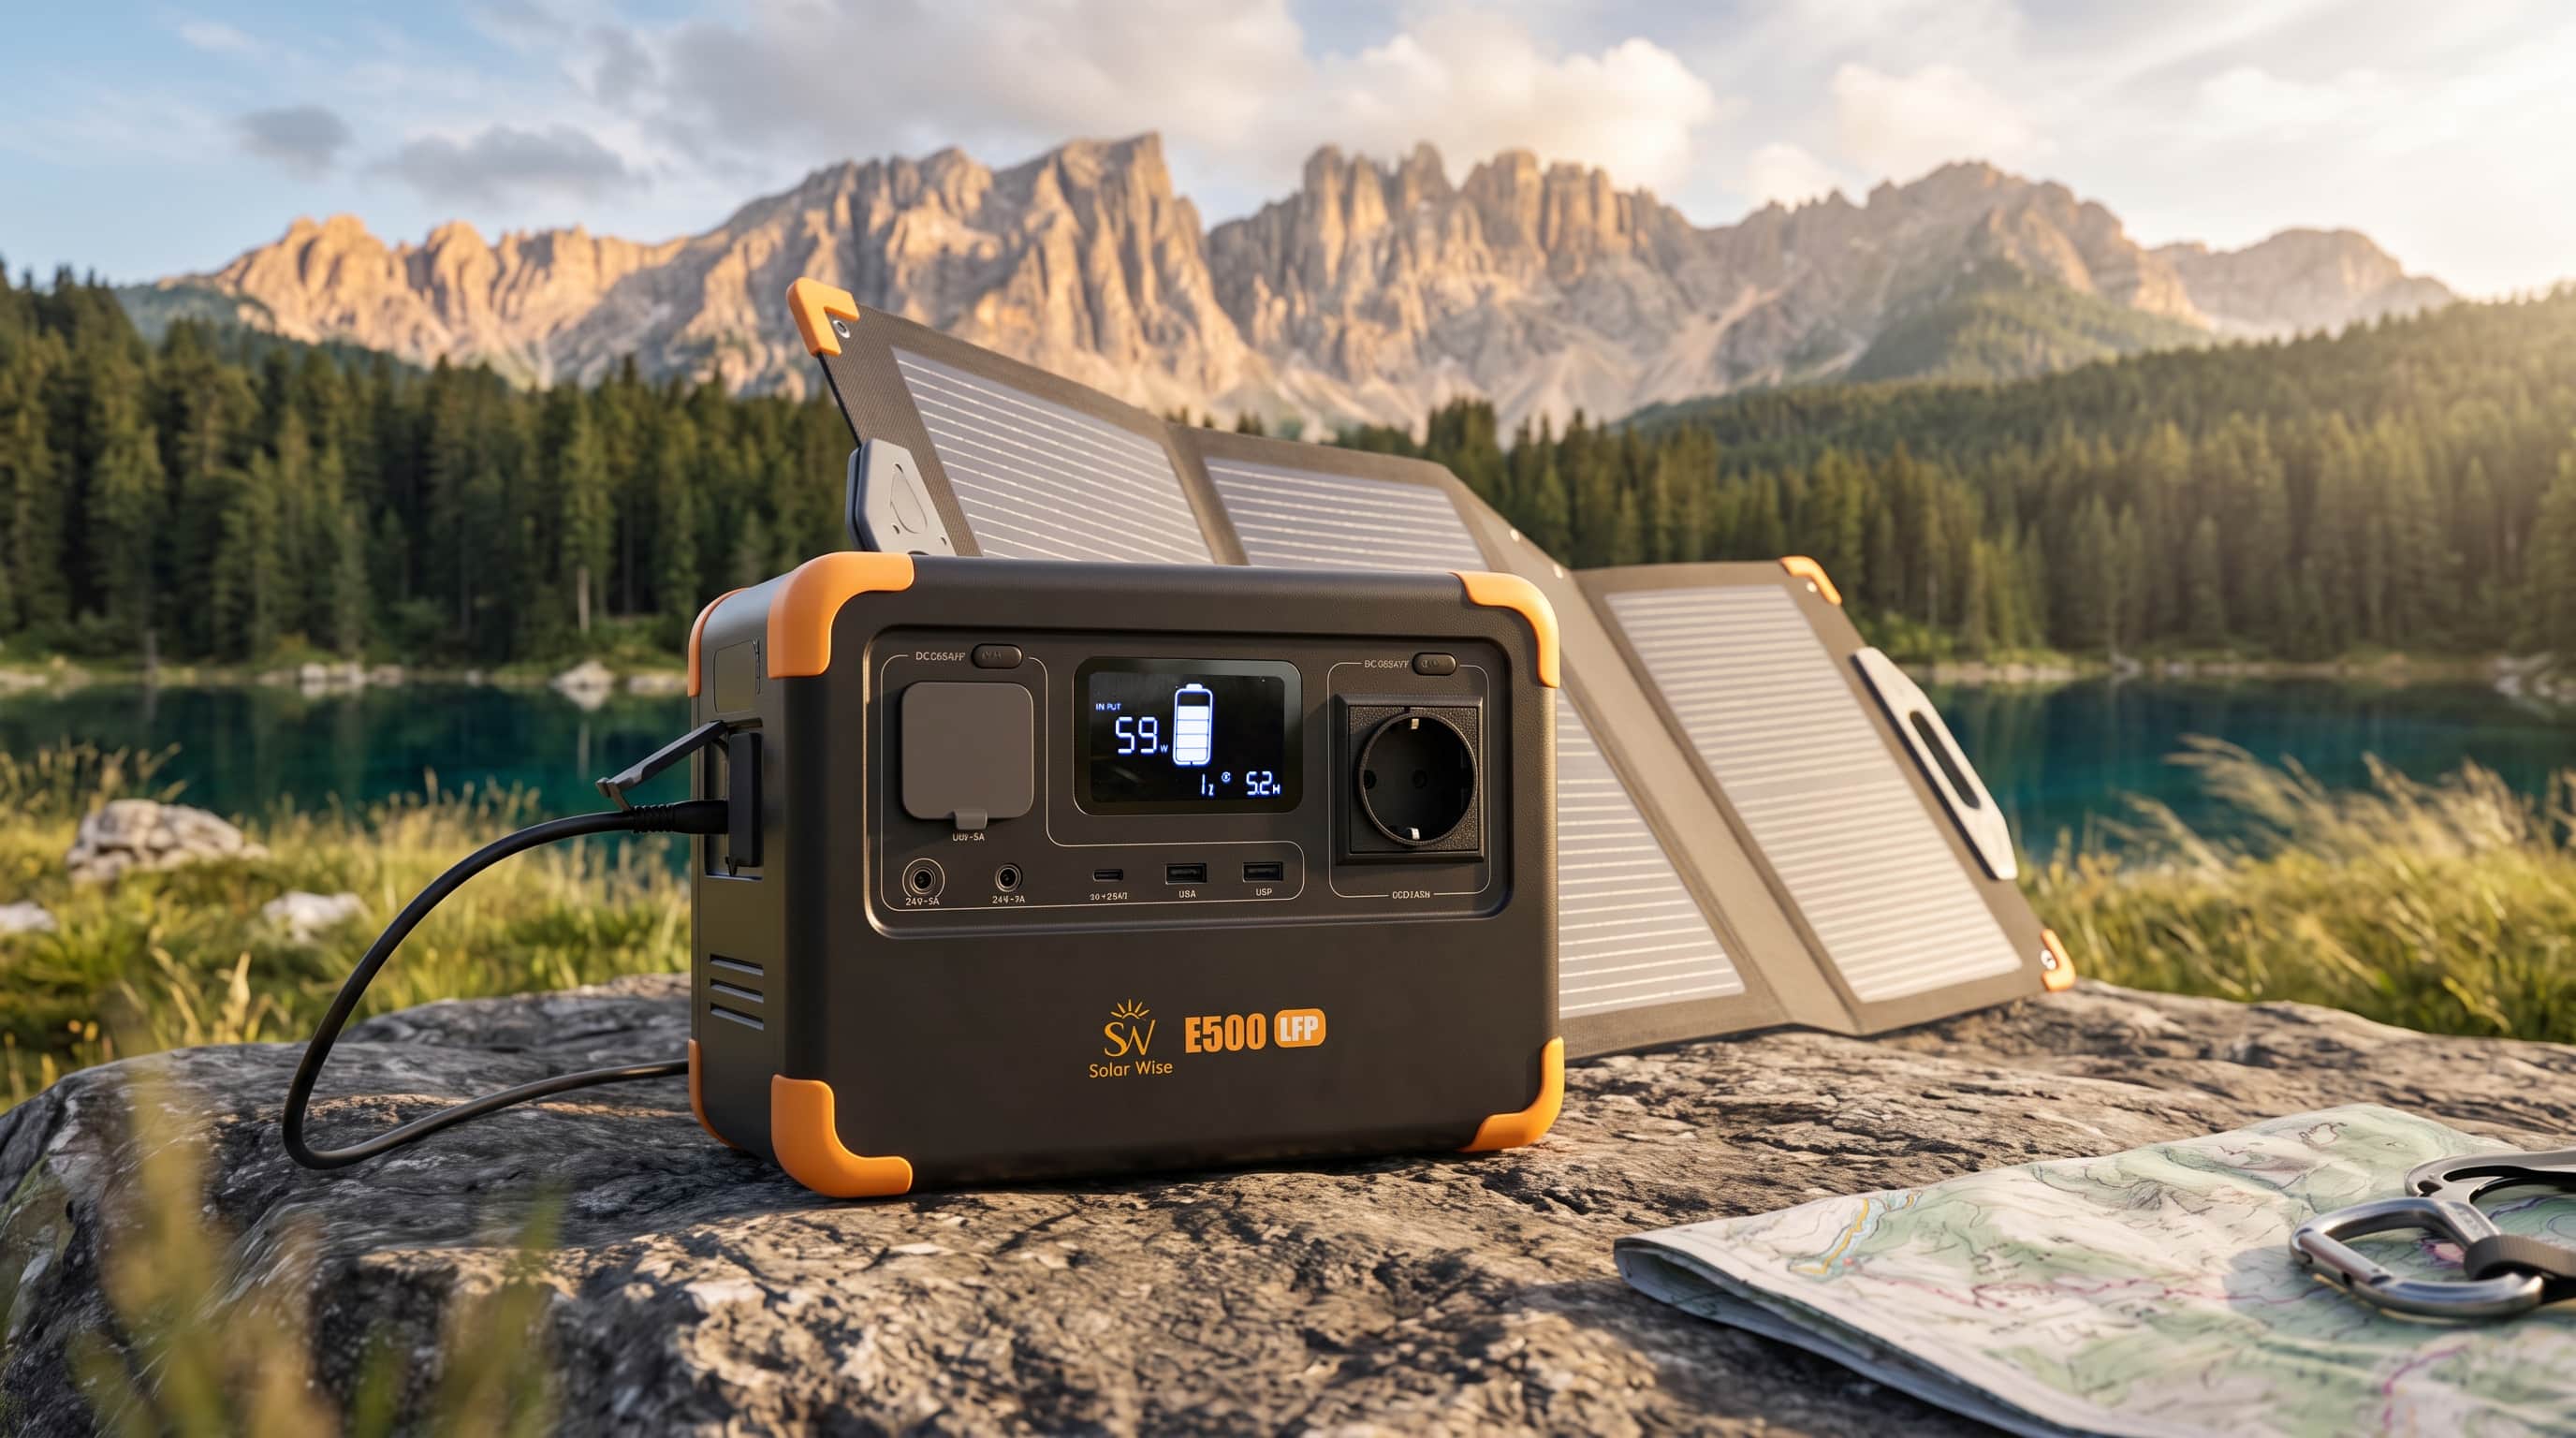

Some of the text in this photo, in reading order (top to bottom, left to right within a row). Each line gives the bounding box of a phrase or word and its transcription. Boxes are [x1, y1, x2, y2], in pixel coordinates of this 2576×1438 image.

[1178, 889, 1197, 899] USA
[1255, 888, 1273, 897] USP
[1184, 1012, 1319, 1054] E500 LFP
[1089, 1060, 1174, 1078] Solar Wise
